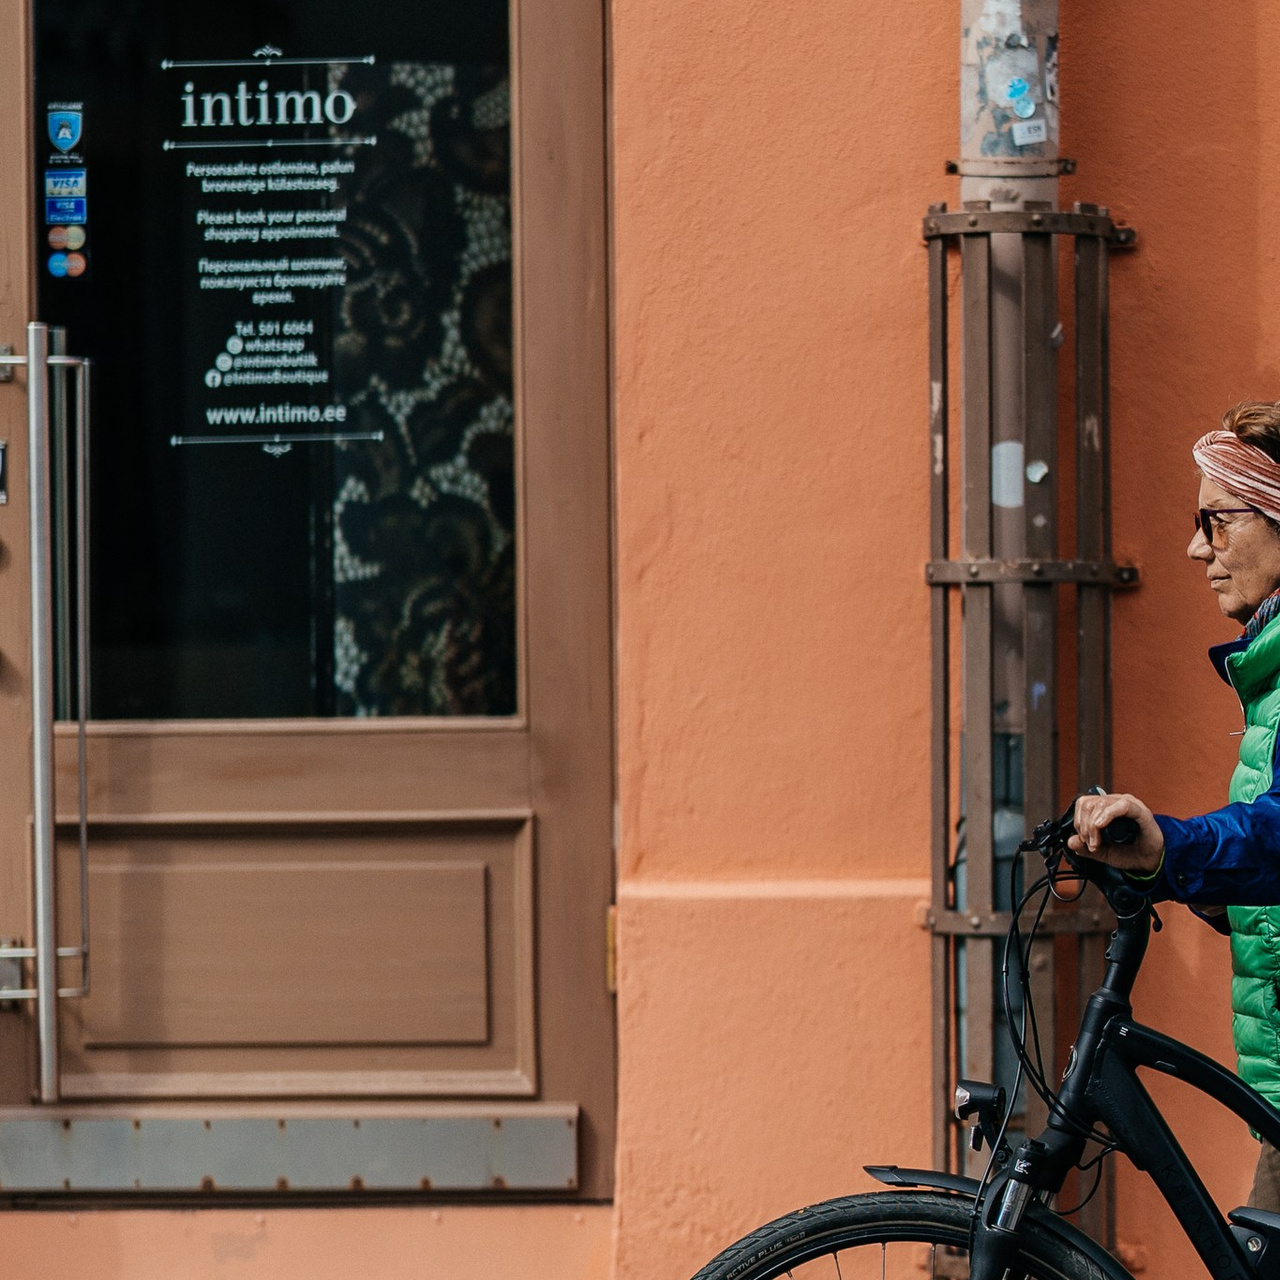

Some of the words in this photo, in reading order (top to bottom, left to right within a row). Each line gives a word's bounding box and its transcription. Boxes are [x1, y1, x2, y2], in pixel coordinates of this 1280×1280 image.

[181, 80, 357, 127] intimo
[186, 161, 257, 177] Personaalne
[320, 159, 355, 176] palun
[52, 179, 79, 188] VISA
[202, 178, 266, 194] broneerige
[197, 209, 234, 225] Please
[236, 208, 266, 223] book
[267, 209, 295, 226] your
[296, 206, 347, 224] personal
[204, 226, 260, 243] shopping
[261, 225, 341, 242] appointment.
[235, 322, 256, 336] Tel.
[244, 338, 305, 354] whatsapp
[206, 402, 347, 425] www.intimo.ee
[726, 1256, 757, 1280] ACTIVE
[757, 1242, 784, 1259] PLUS
